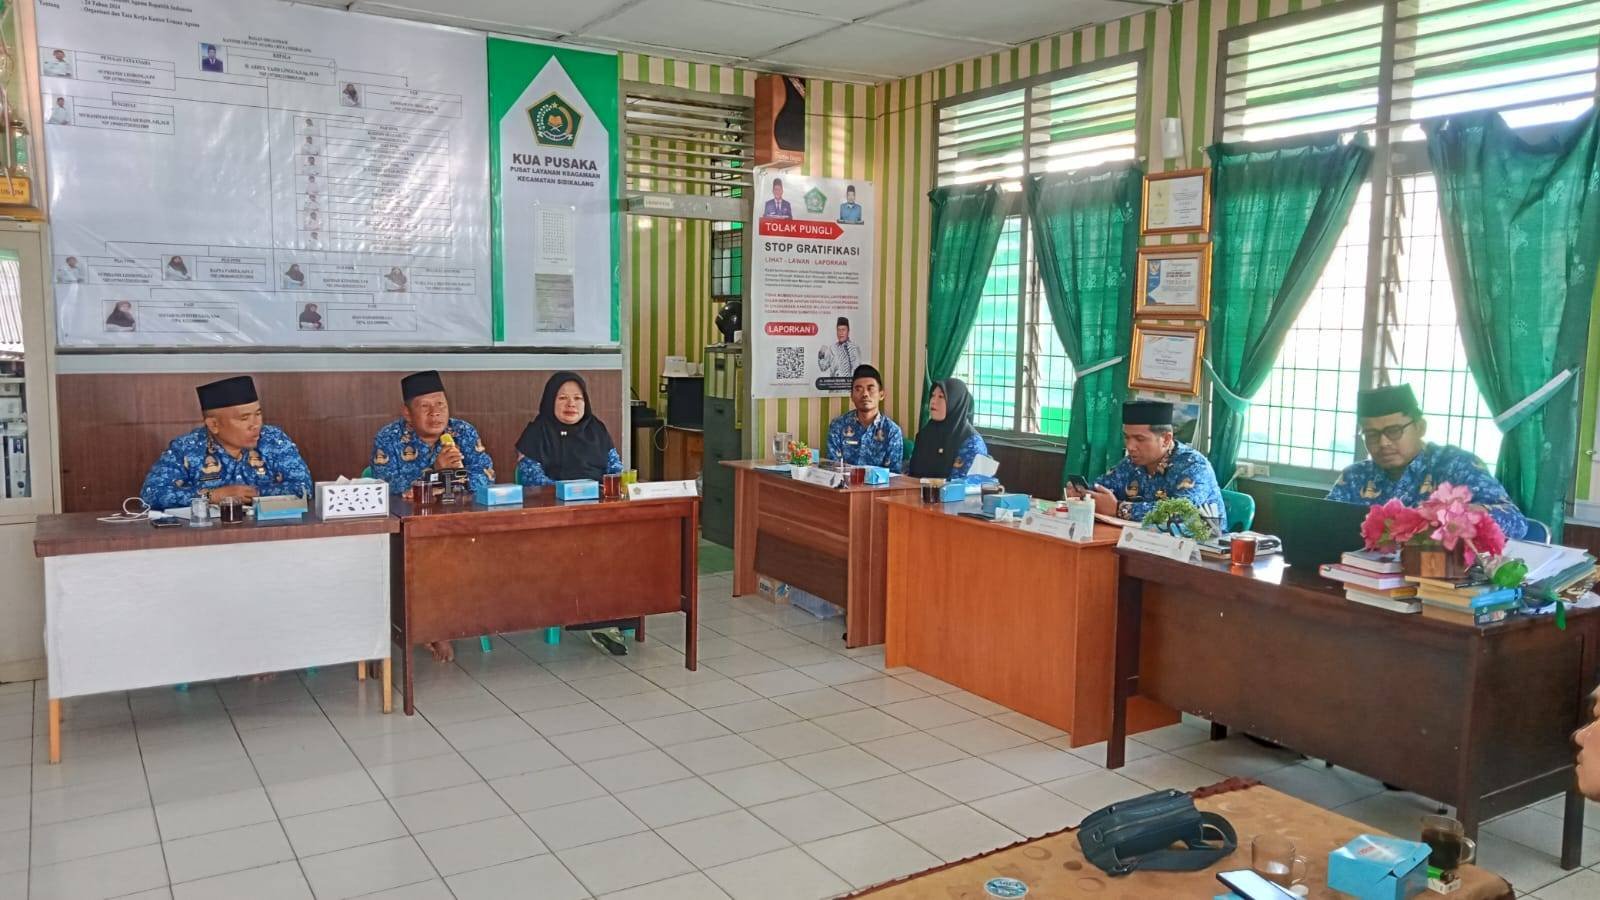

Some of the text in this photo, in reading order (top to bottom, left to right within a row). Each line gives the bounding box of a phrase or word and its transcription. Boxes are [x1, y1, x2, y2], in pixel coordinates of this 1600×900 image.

[512, 153, 597, 171] KUA PUSAKA
[510, 166, 600, 179] PUSAT LAYANAN KEAGAMAAN
[517, 175, 594, 187] KECAMATAN SIDIKALANG
[765, 222, 833, 235] TOLAK PUNGLI
[764, 242, 860, 256] STOP GRATIFIKASI
[768, 325, 811, 334] LAPORKAN
